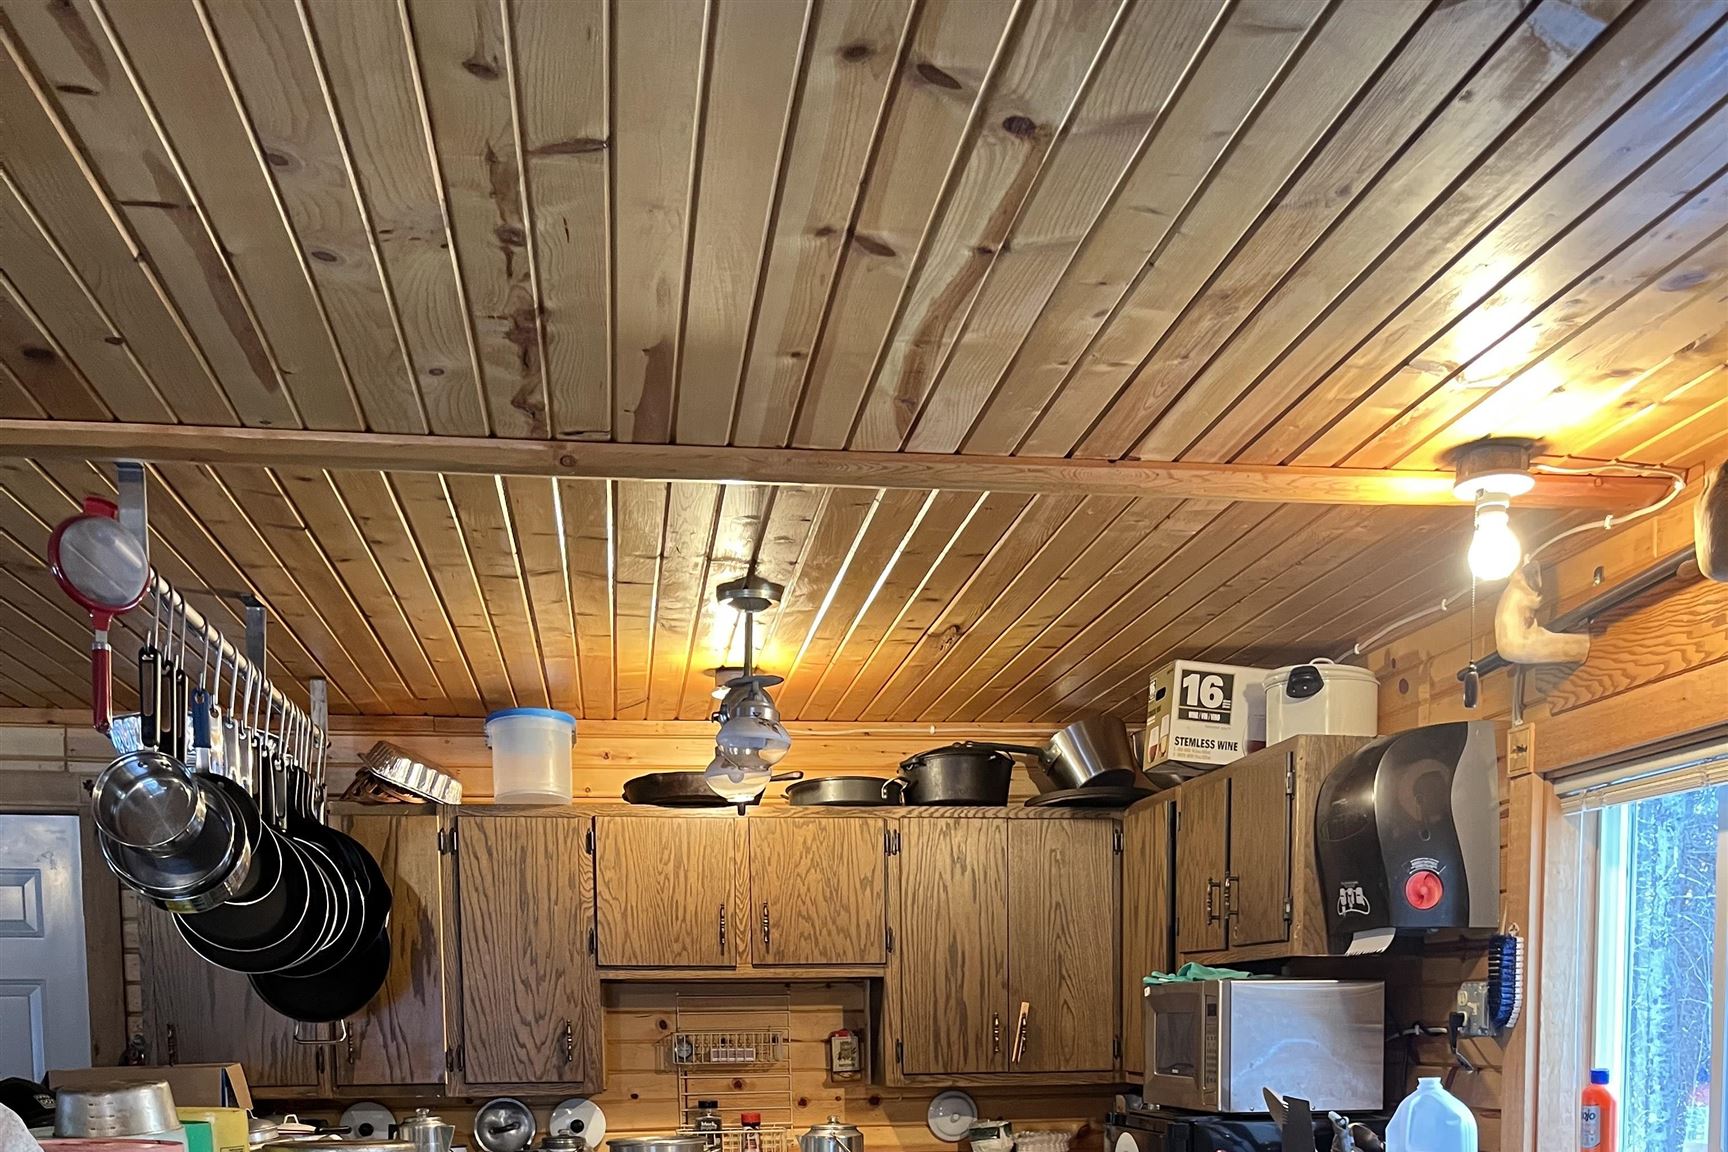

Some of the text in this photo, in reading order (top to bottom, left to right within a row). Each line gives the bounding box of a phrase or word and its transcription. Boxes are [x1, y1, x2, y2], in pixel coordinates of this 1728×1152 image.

[1183, 673, 1224, 709] 16
[1174, 736, 1238, 751] STEMLESS WINE
